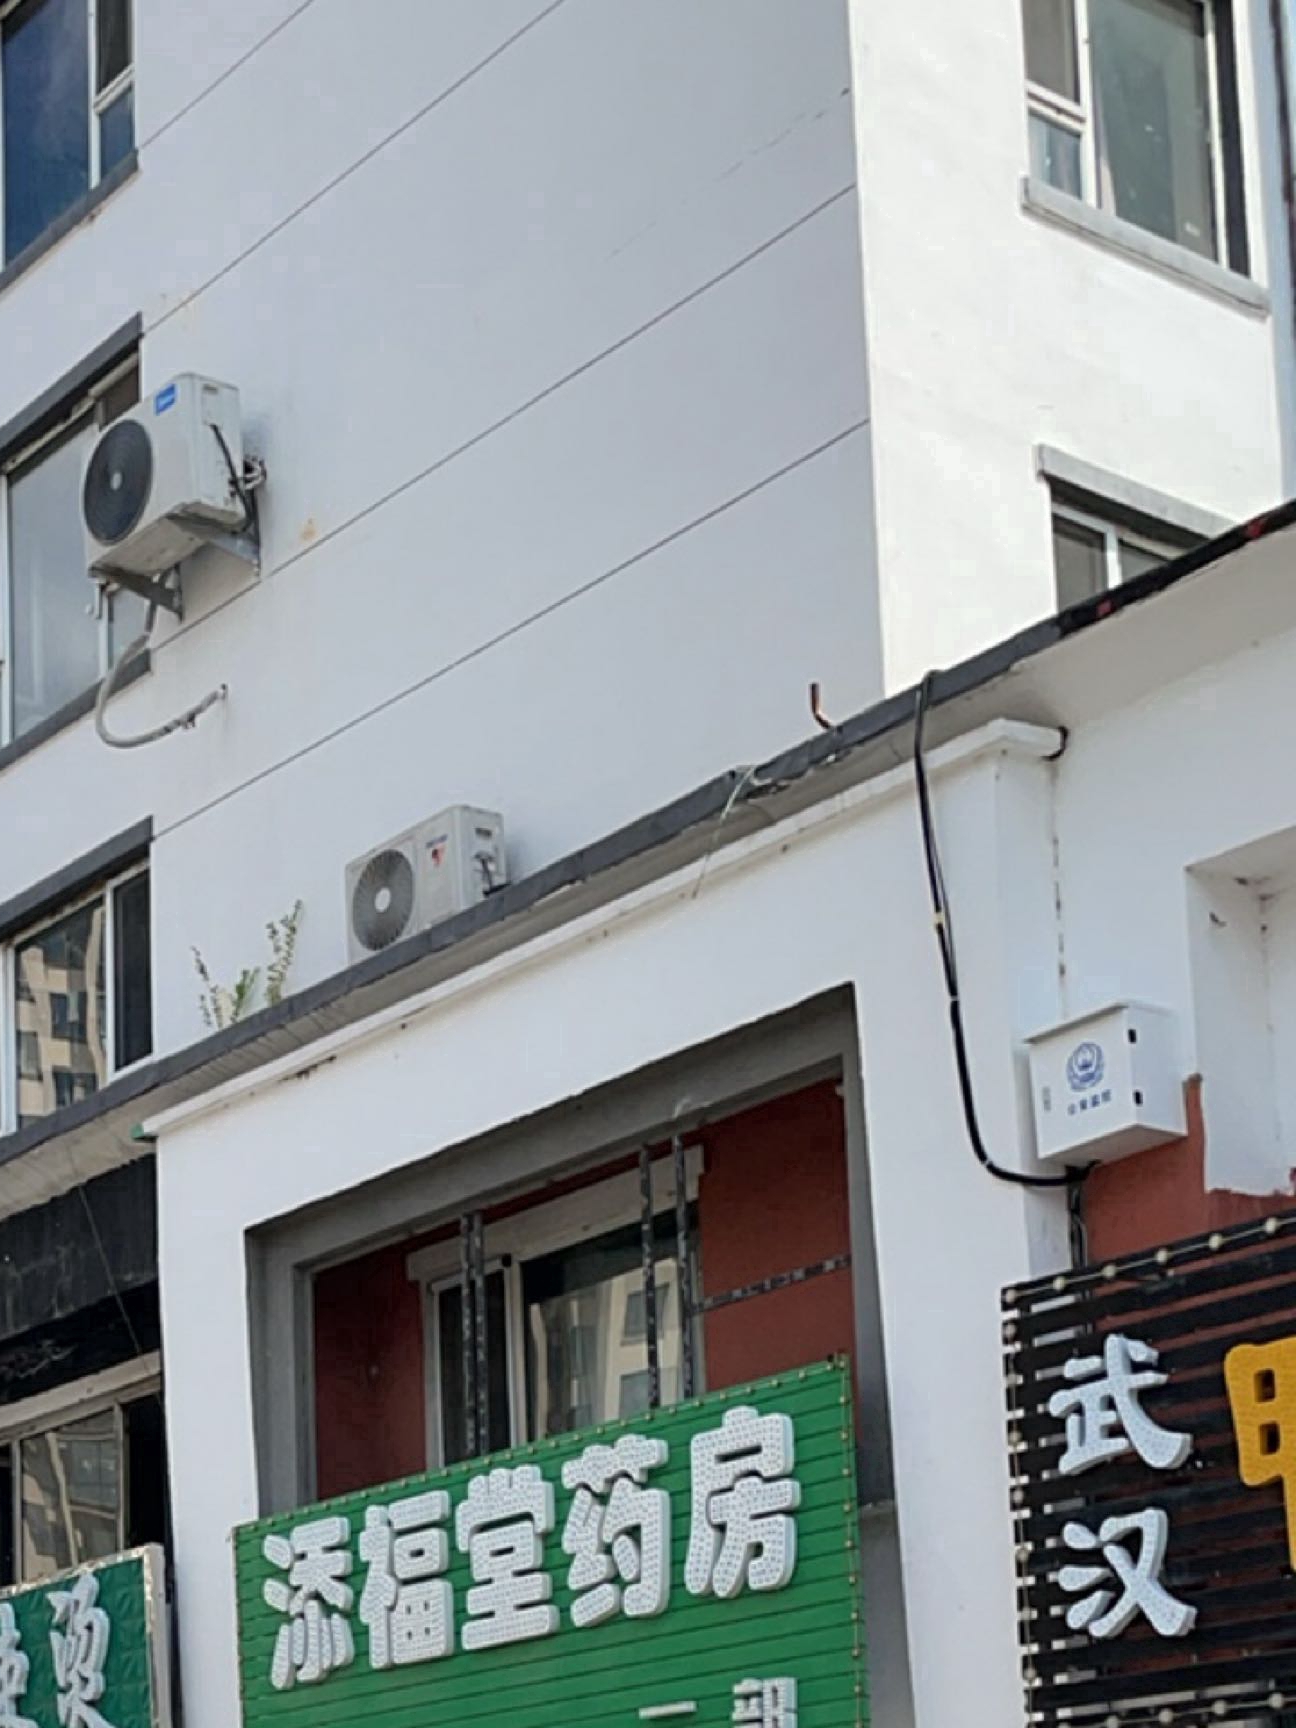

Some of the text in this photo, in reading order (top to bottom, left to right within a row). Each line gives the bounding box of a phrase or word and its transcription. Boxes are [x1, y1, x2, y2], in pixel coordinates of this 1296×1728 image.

[263, 1406, 800, 1690] 添福堂药房
[1048, 1333, 1197, 1637] 武汉
